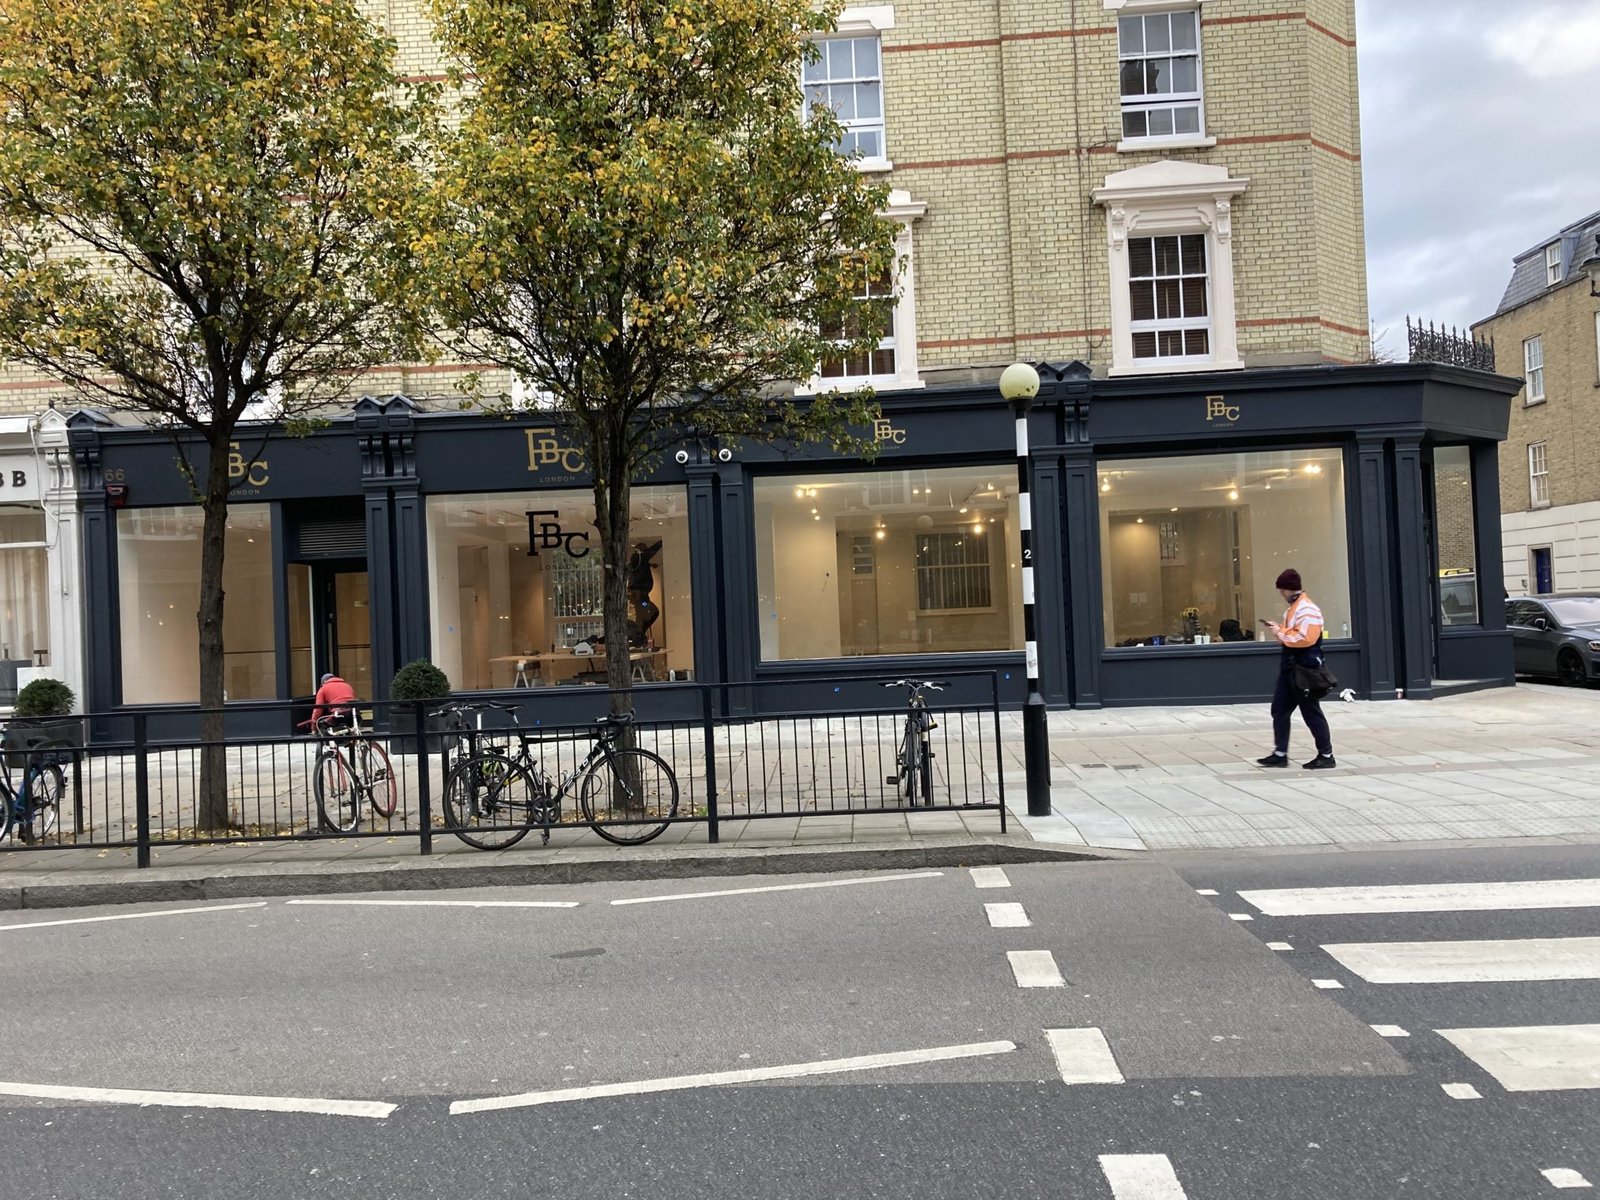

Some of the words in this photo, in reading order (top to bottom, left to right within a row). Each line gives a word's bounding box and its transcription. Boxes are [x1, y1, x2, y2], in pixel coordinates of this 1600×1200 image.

[1205, 395, 1240, 421] FBC
[872, 418, 906, 444] FBC
[228, 441, 270, 486] BC
[524, 428, 585, 473] FBC
[104, 468, 125, 482] 66
[540, 475, 576, 483] LONDON
[525, 510, 590, 558] FBC
[1024, 549, 1032, 559] 2
